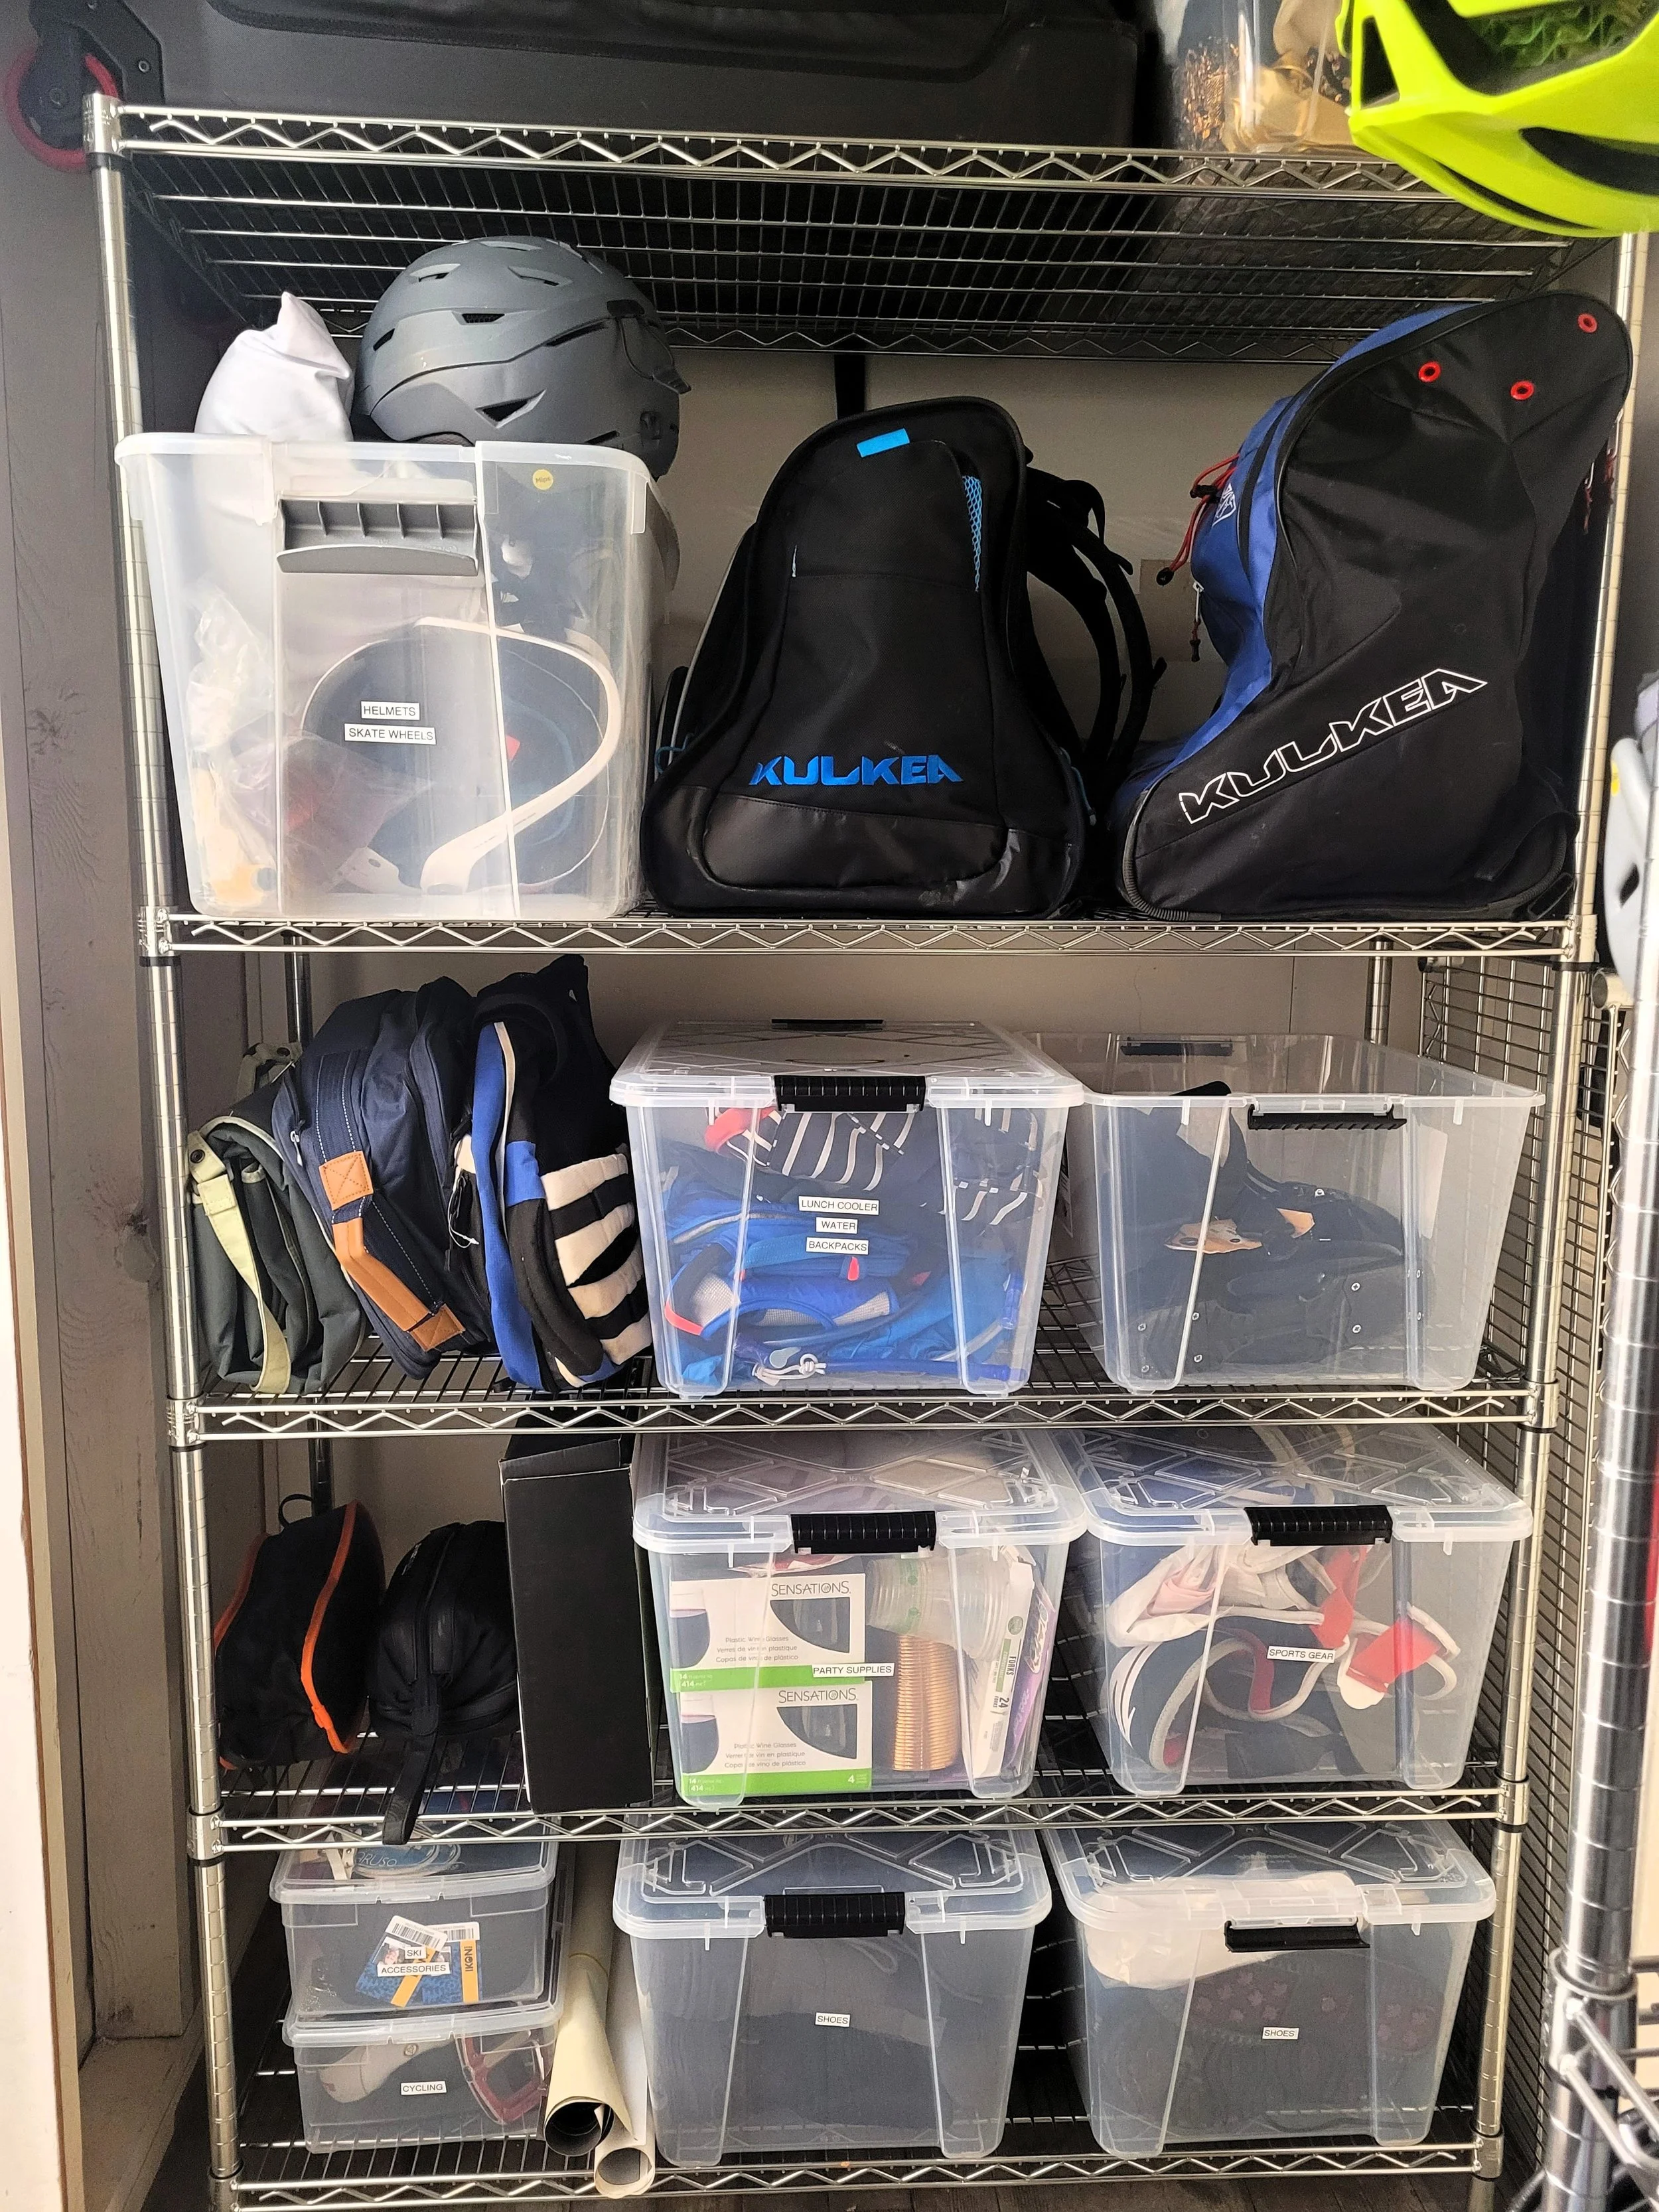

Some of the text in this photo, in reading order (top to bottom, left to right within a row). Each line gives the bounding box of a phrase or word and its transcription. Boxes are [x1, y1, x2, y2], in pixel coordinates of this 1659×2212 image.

[364, 706, 415, 716] HELMETS
[349, 728, 433, 741] SKATE WHEELS
[1179, 668, 1488, 824] KULKEA
[749, 755, 964, 785] KULKEA
[802, 1199, 877, 1211] LUNCH COOLER
[822, 1220, 856, 1230] WATER
[809, 1241, 867, 1252] BACKPACKS
[771, 1581, 849, 1597] SENSATIONS
[1269, 1649, 1306, 1658] SPORTS
[1006, 1656, 1017, 1676] FORKS
[778, 1688, 857, 1704] SENSATIONS
[998, 1697, 1010, 1708] 24
[847, 1774, 855, 1783] 4
[464, 1948, 474, 1972] IKON
[382, 1964, 446, 1974] ACCESSORIES
[817, 2016, 848, 2024] SHOES
